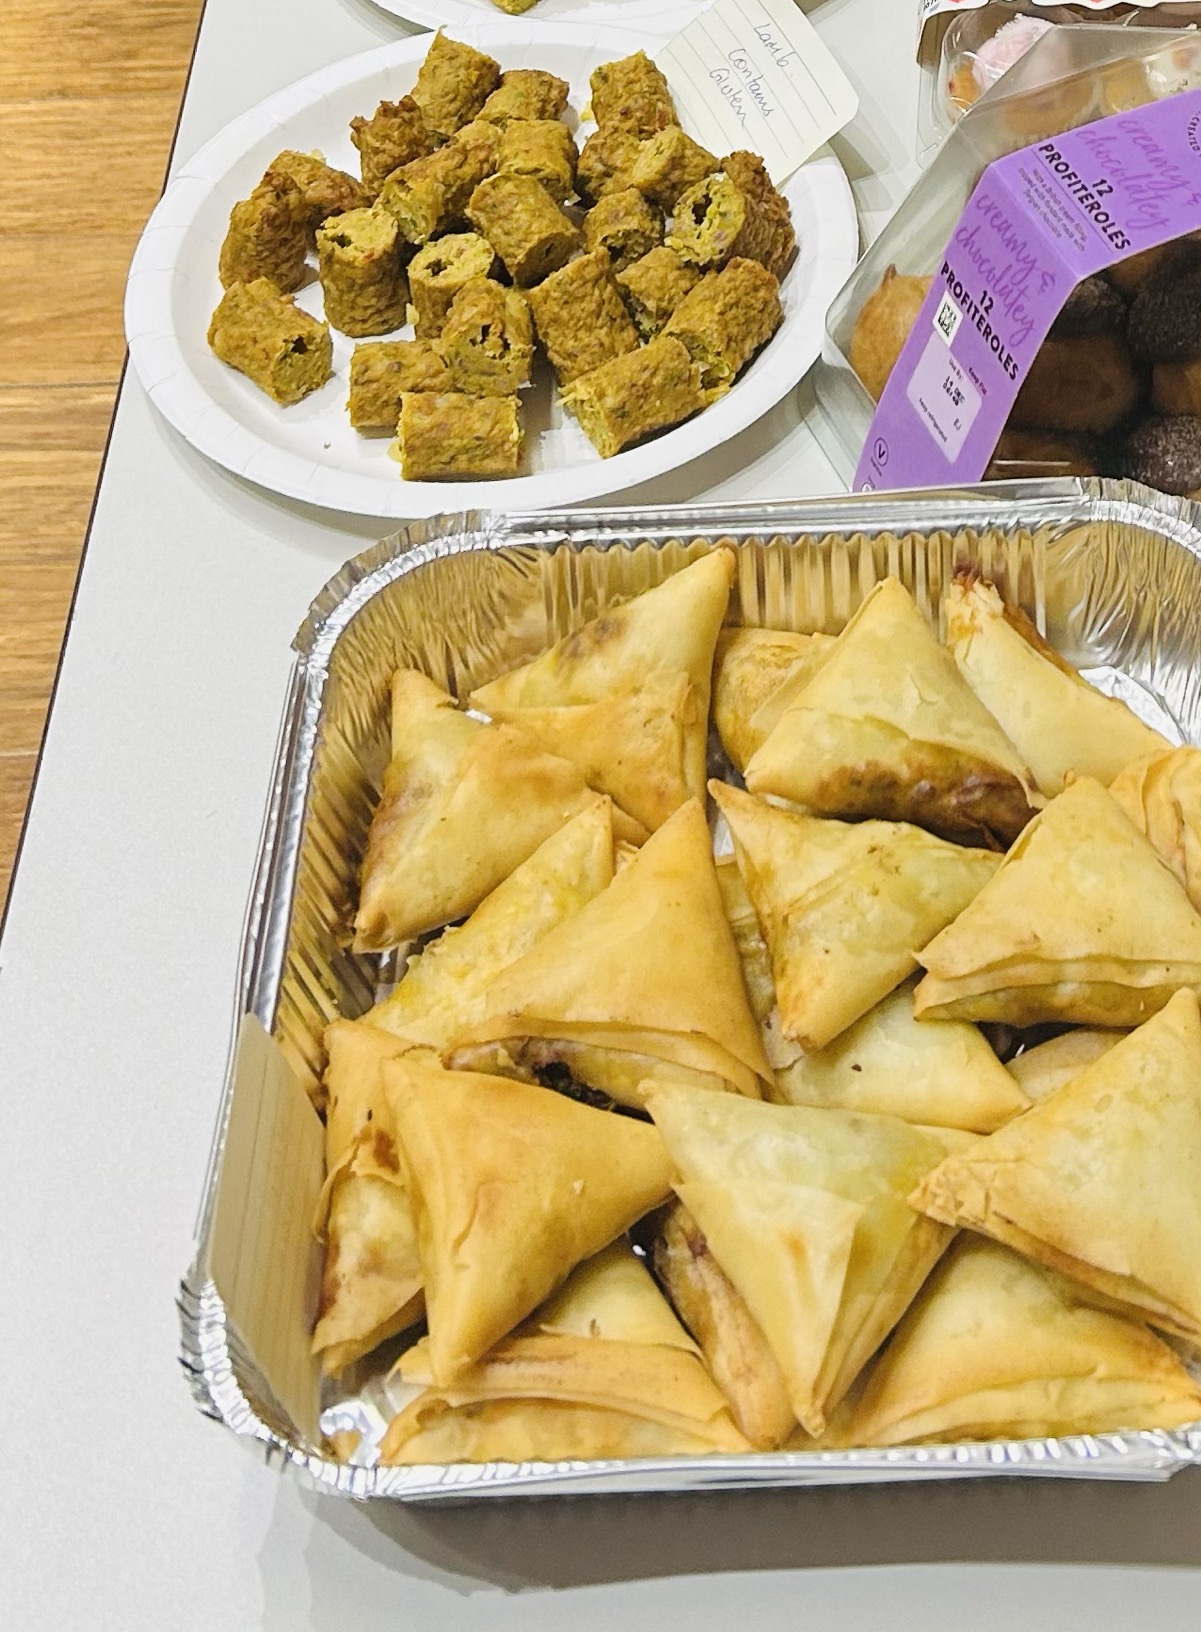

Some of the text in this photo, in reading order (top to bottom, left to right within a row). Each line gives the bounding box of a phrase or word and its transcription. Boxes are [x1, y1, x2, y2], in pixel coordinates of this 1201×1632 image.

[709, 68, 746, 128] Gluten
[728, 49, 774, 117] Contains
[1118, 120, 1190, 191] creamy
[1188, 116, 1200, 152] CREATED
[1038, 143, 1131, 250] PROFITEROLES
[1076, 130, 1172, 230] chocolatey
[1092, 178, 1114, 198] 12
[976, 194, 1038, 286] creamy
[940, 261, 1020, 381] PROFITEROLES
[956, 224, 1036, 348] chocolatey
[980, 290, 994, 317] 12
